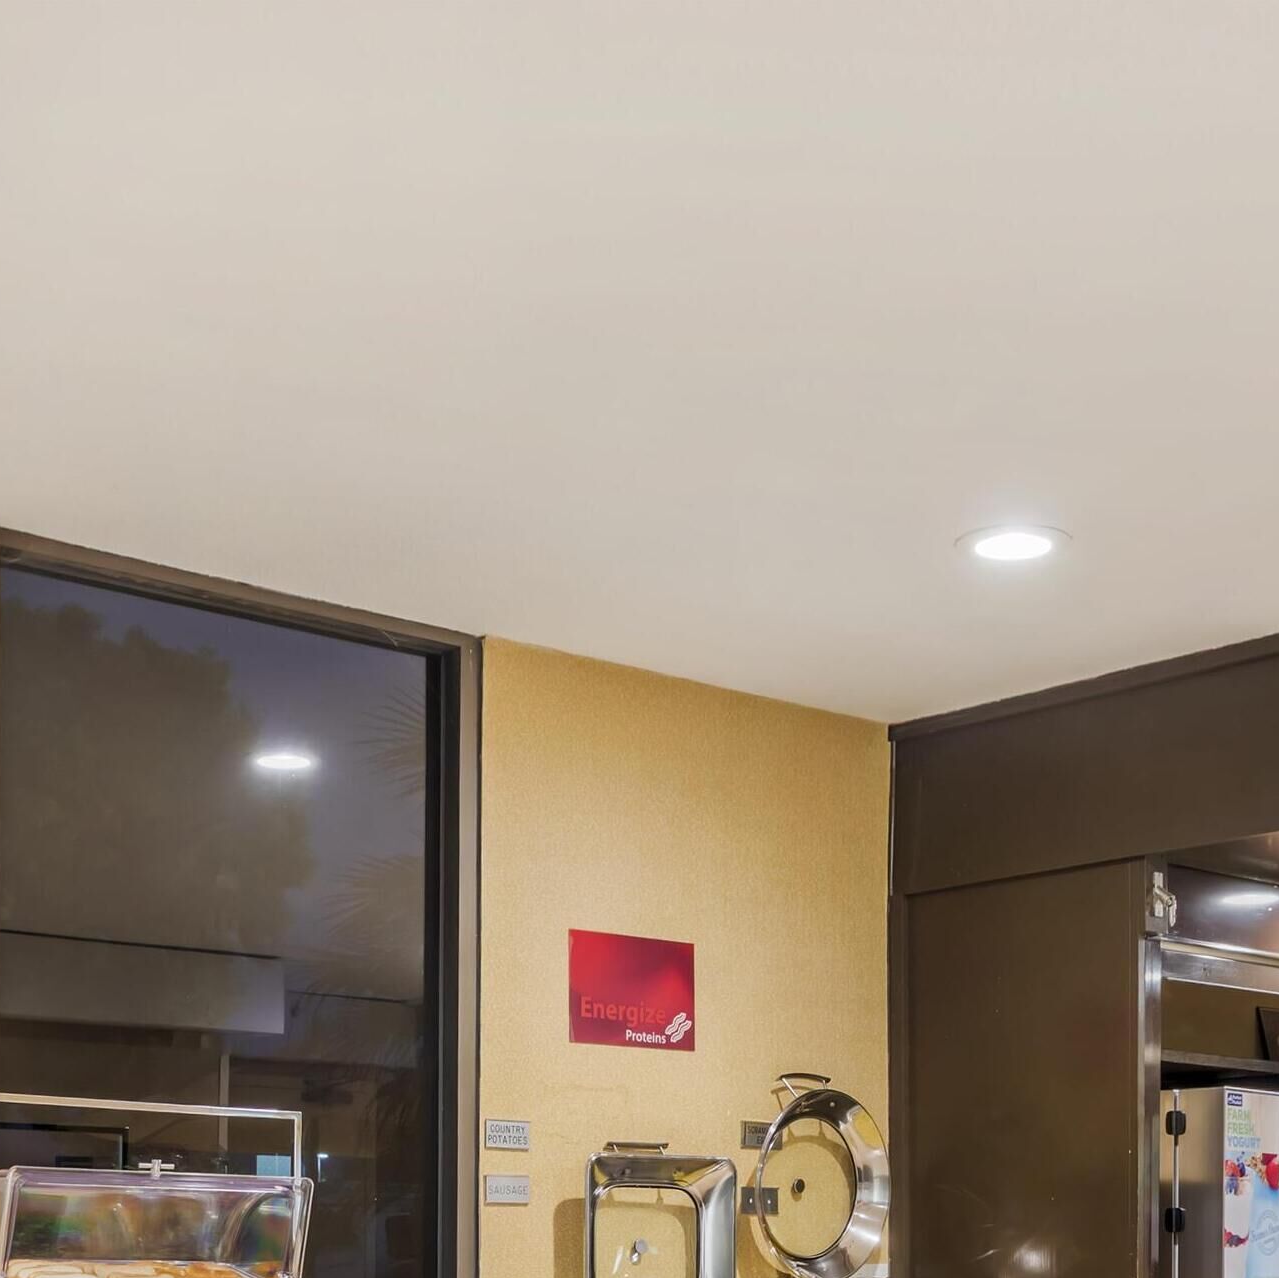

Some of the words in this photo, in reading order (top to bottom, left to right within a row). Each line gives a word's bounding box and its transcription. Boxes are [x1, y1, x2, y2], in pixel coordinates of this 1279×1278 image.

[581, 996, 667, 1028] Energize
[625, 1029, 667, 1044] Proteins
[1227, 1108, 1251, 1121] FARM
[490, 1124, 526, 1136] COUNTRY
[1227, 1122, 1255, 1136] FRESH
[488, 1134, 528, 1145] POTATOES
[1227, 1136, 1261, 1149] YOGURT
[488, 1184, 529, 1196] SAUSAGE
